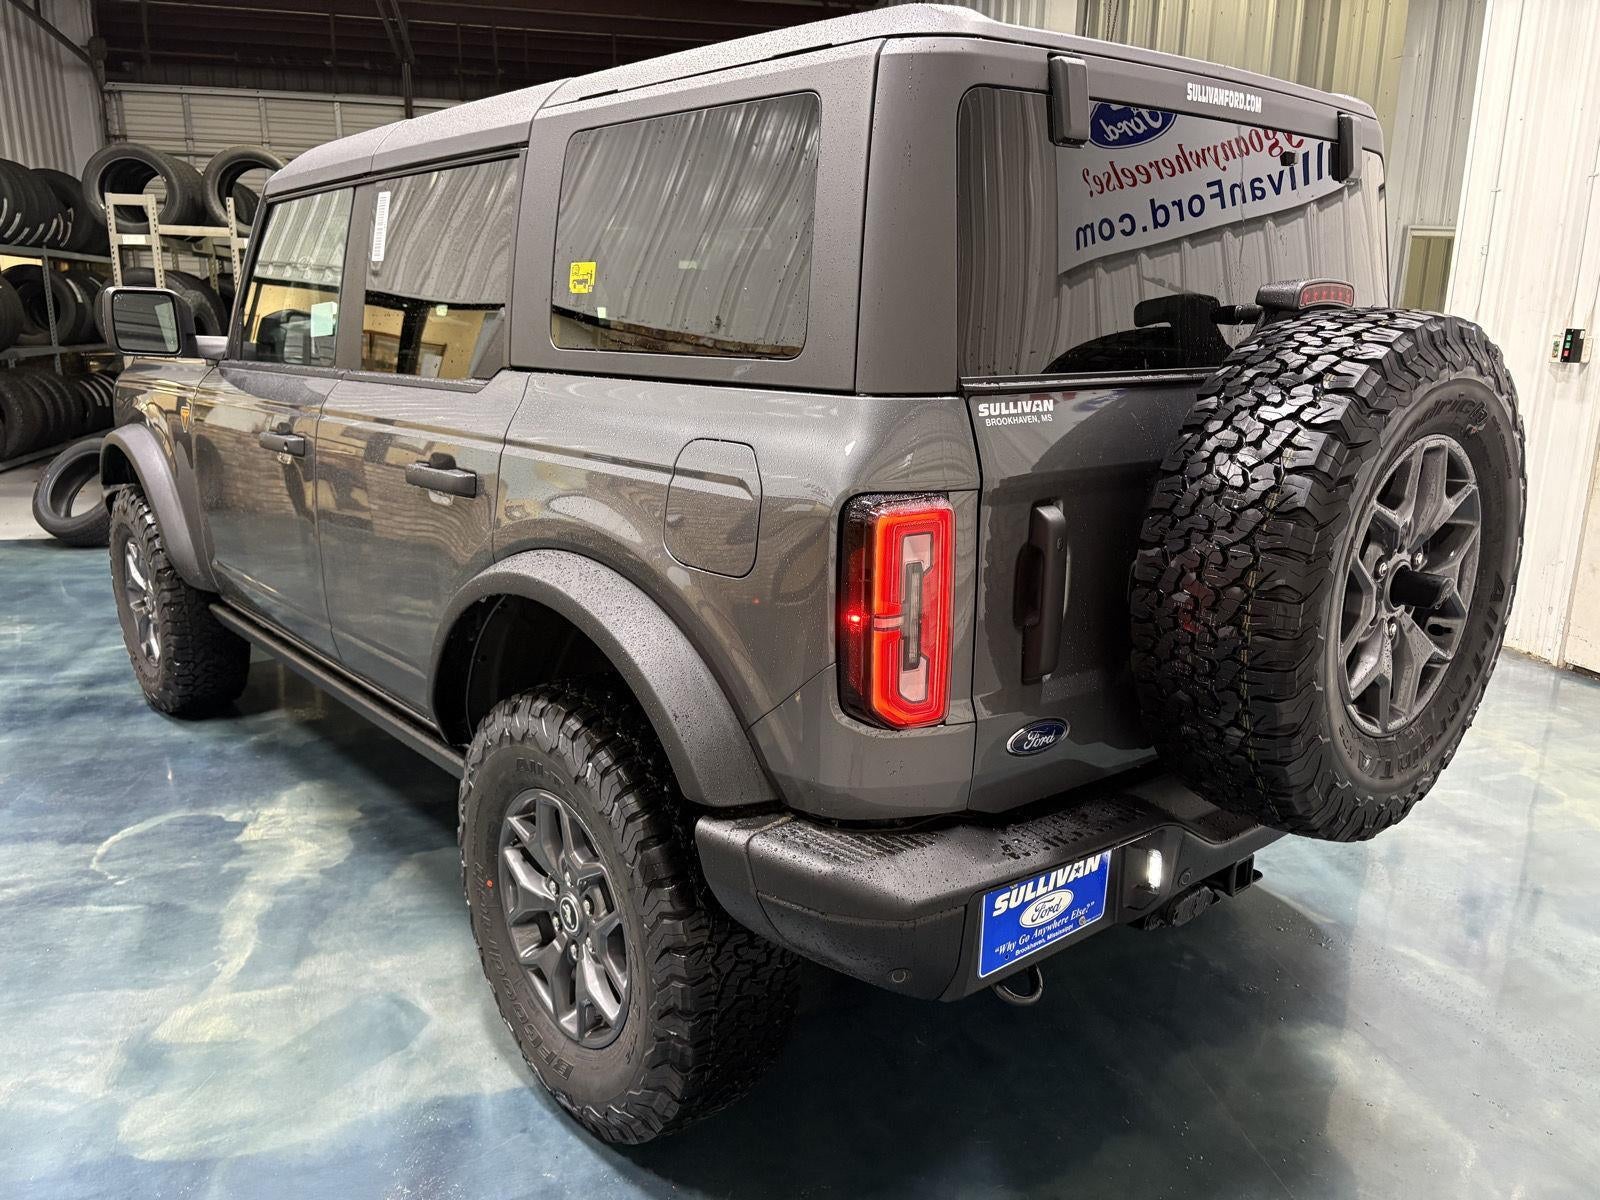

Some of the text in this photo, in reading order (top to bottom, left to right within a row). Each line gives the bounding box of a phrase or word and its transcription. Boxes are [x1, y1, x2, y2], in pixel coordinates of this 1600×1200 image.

[1187, 82, 1262, 113] SULLIVANFORD.COM
[978, 399, 1054, 417] SULLIVAN
[985, 414, 1053, 427] BROOKHAVEN, MS
[1023, 729, 1056, 750] Ford
[992, 854, 1101, 917] SULLIVAN
[1031, 896, 1062, 922] Ford
[1015, 924, 1074, 956] Brookhaven, Mississippi
[1019, 934, 1031, 946] Go
[1031, 916, 1069, 939] Anywhere
